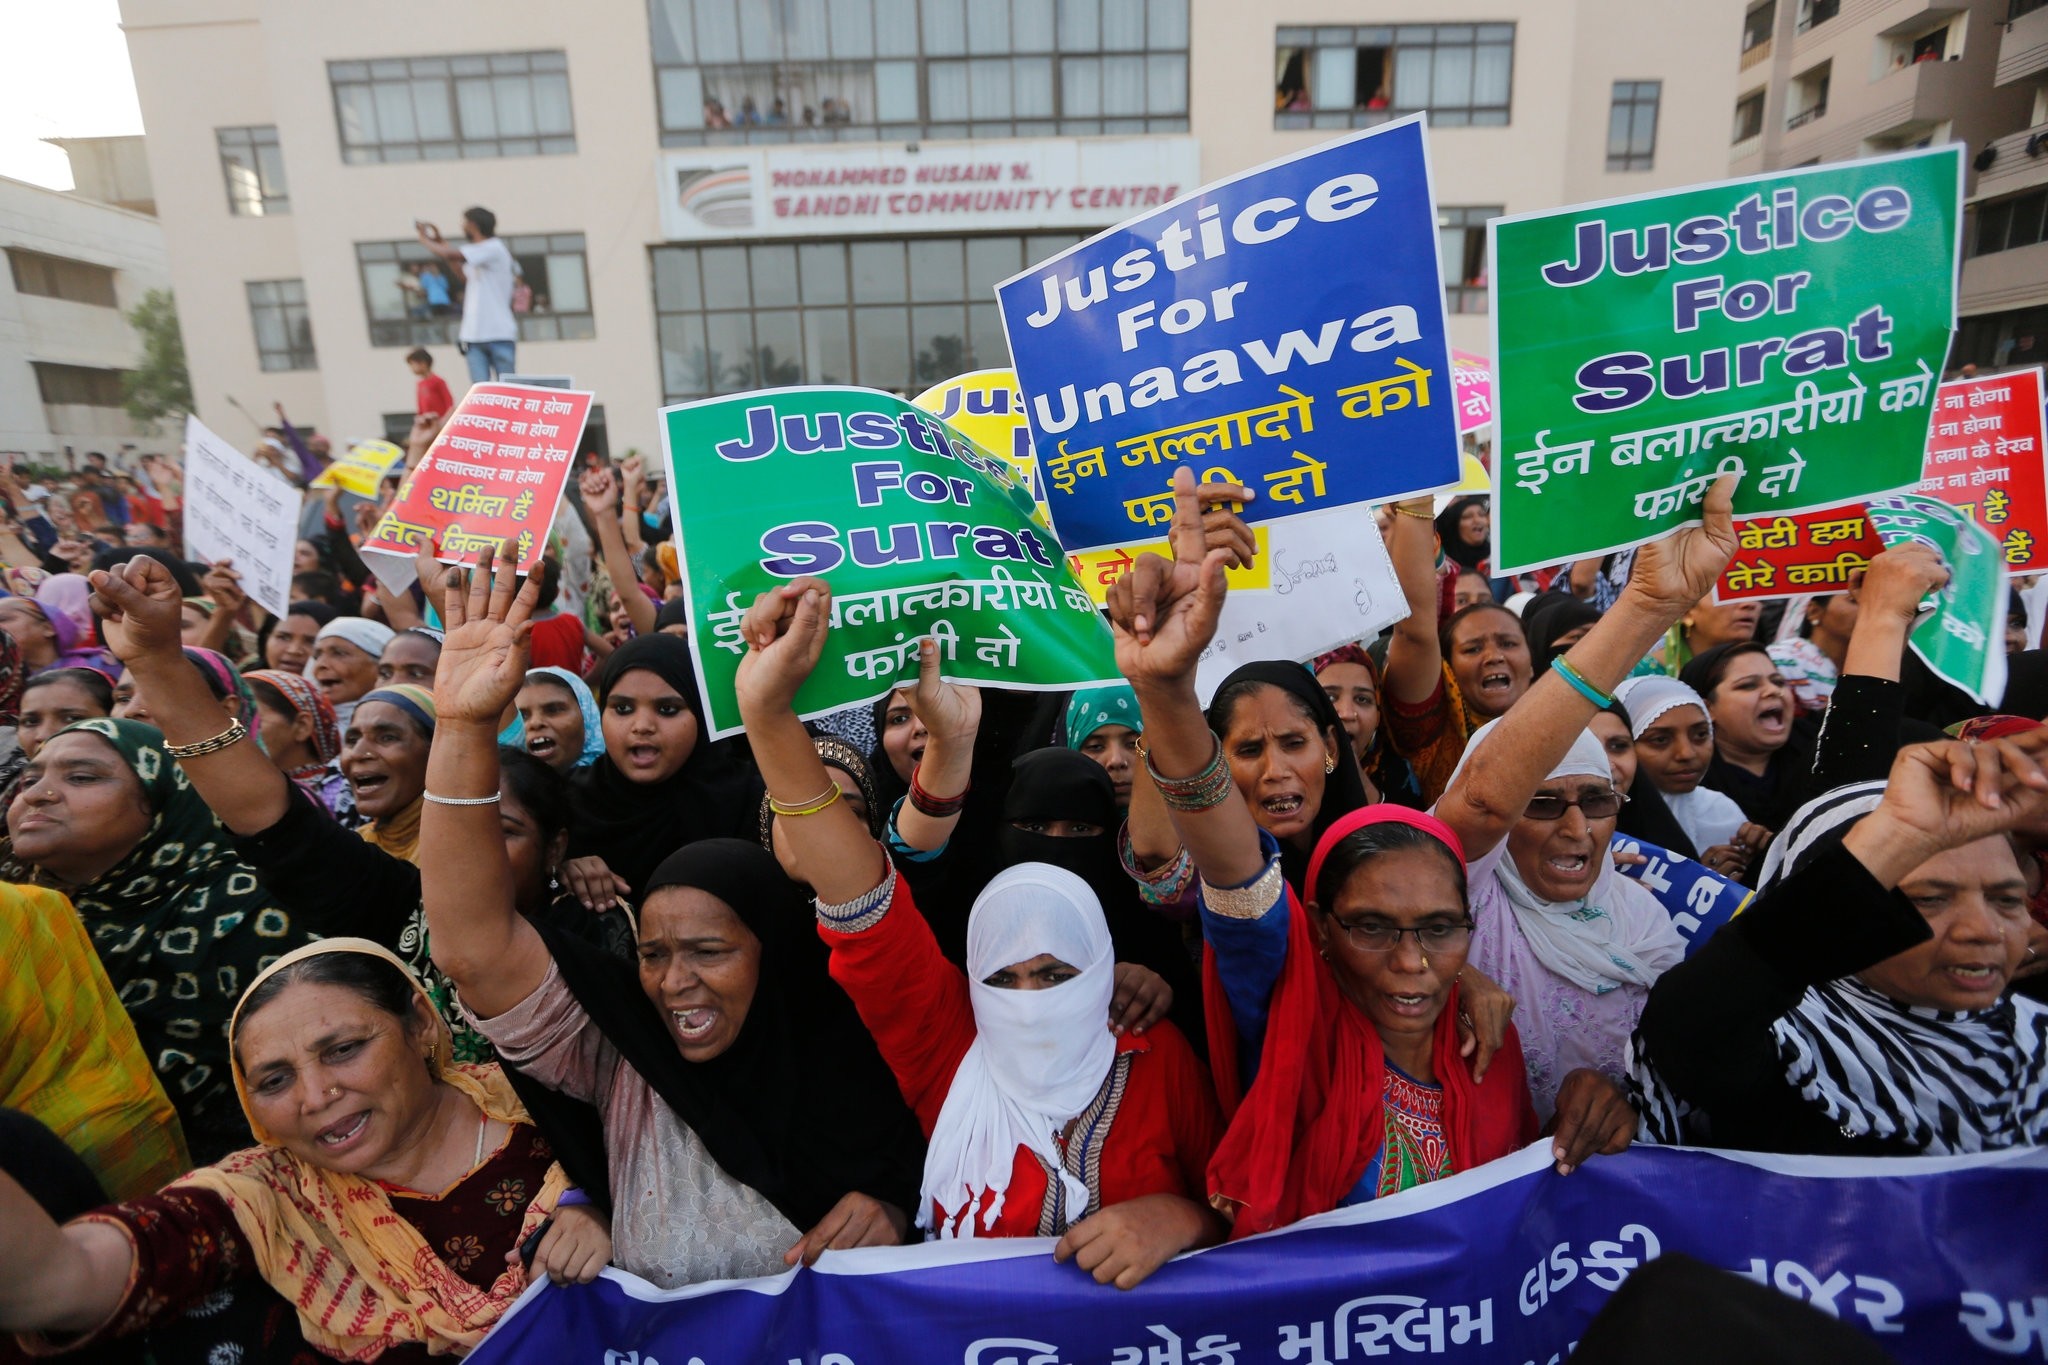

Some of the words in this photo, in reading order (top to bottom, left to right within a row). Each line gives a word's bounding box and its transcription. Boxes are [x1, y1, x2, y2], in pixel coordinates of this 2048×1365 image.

[772, 168, 906, 188] MOHAMMED
[914, 164, 1000, 183] HUSAIN
[774, 194, 878, 217] GANDHI
[887, 188, 1062, 215] COMMUNITY
[1070, 185, 1180, 208] CENTRE
[1026, 173, 1379, 328] Justice
[1541, 186, 1910, 287] Justice
[1117, 281, 1248, 352] For
[1673, 271, 1810, 333] For
[1033, 304, 1422, 434] Unaawa
[1572, 304, 1894, 413] Surat
[524, 399, 541, 413] ना
[542, 396, 574, 416] होगा
[1462, 389, 1490, 417] दो
[1944, 395, 1964, 409] ना
[1968, 386, 2010, 407] होगा
[450, 435, 494, 459] कानून
[497, 443, 526, 459] लगा
[527, 443, 543, 461] के
[511, 421, 528, 435] ना
[529, 418, 561, 438] होगा
[716, 405, 1015, 463] Justice
[1047, 437, 1108, 495] ईन
[1116, 384, 1314, 468] जल्लादो
[1337, 357, 1432, 419] को
[1514, 430, 1595, 495] ईन
[1610, 372, 1867, 467] बलात्कारीयो
[1880, 358, 1934, 414] को
[1935, 447, 1967, 464] लगा
[1971, 439, 1990, 459] के
[1939, 422, 1959, 436] ना
[1962, 414, 2002, 435] होगा
[434, 458, 498, 480] बलात्कार
[498, 468, 516, 482] ना
[515, 465, 546, 484] होगा
[852, 461, 974, 507] For
[1264, 450, 1327, 505] दो
[1757, 447, 1807, 499] दो
[1948, 474, 1967, 487] ना
[1970, 466, 2010, 487] होगा
[1738, 517, 1798, 549] बेटी
[1808, 517, 1864, 545] हम
[1983, 489, 2009, 524] हैं
[760, 520, 1055, 579] Surat
[1726, 559, 1775, 590] तेरे
[2003, 529, 2032, 564] हैं
[976, 623, 1021, 668] दो
[1278, 1294, 1493, 1365] મસ્લિમ
